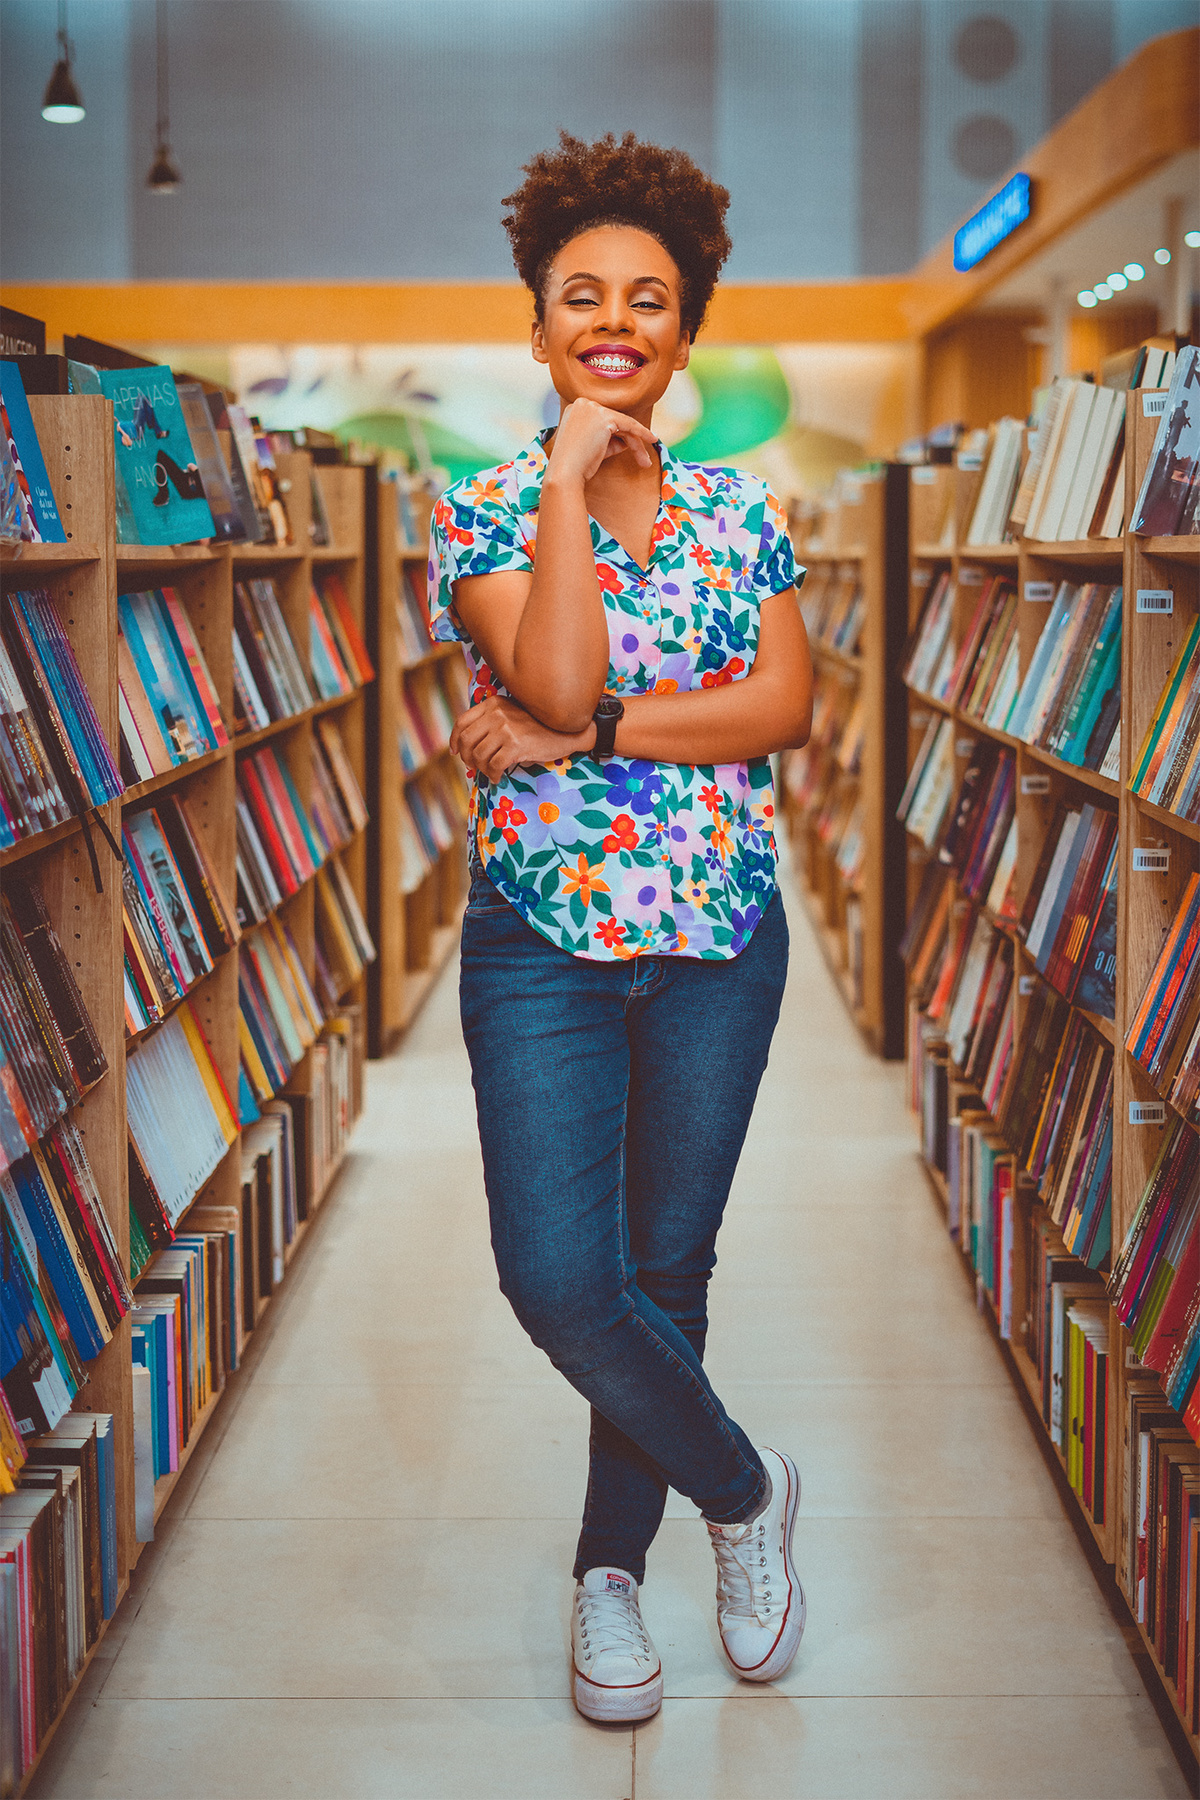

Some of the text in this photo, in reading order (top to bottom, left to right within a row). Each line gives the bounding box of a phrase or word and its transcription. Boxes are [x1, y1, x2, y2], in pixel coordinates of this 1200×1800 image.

[113, 382, 175, 411] APENAS
[134, 462, 168, 488] ANO
[24, 953, 51, 1008] TESTAMENTO
[62, 1044, 75, 1071] FINAL
[1146, 1182, 1157, 1203] FINAL
